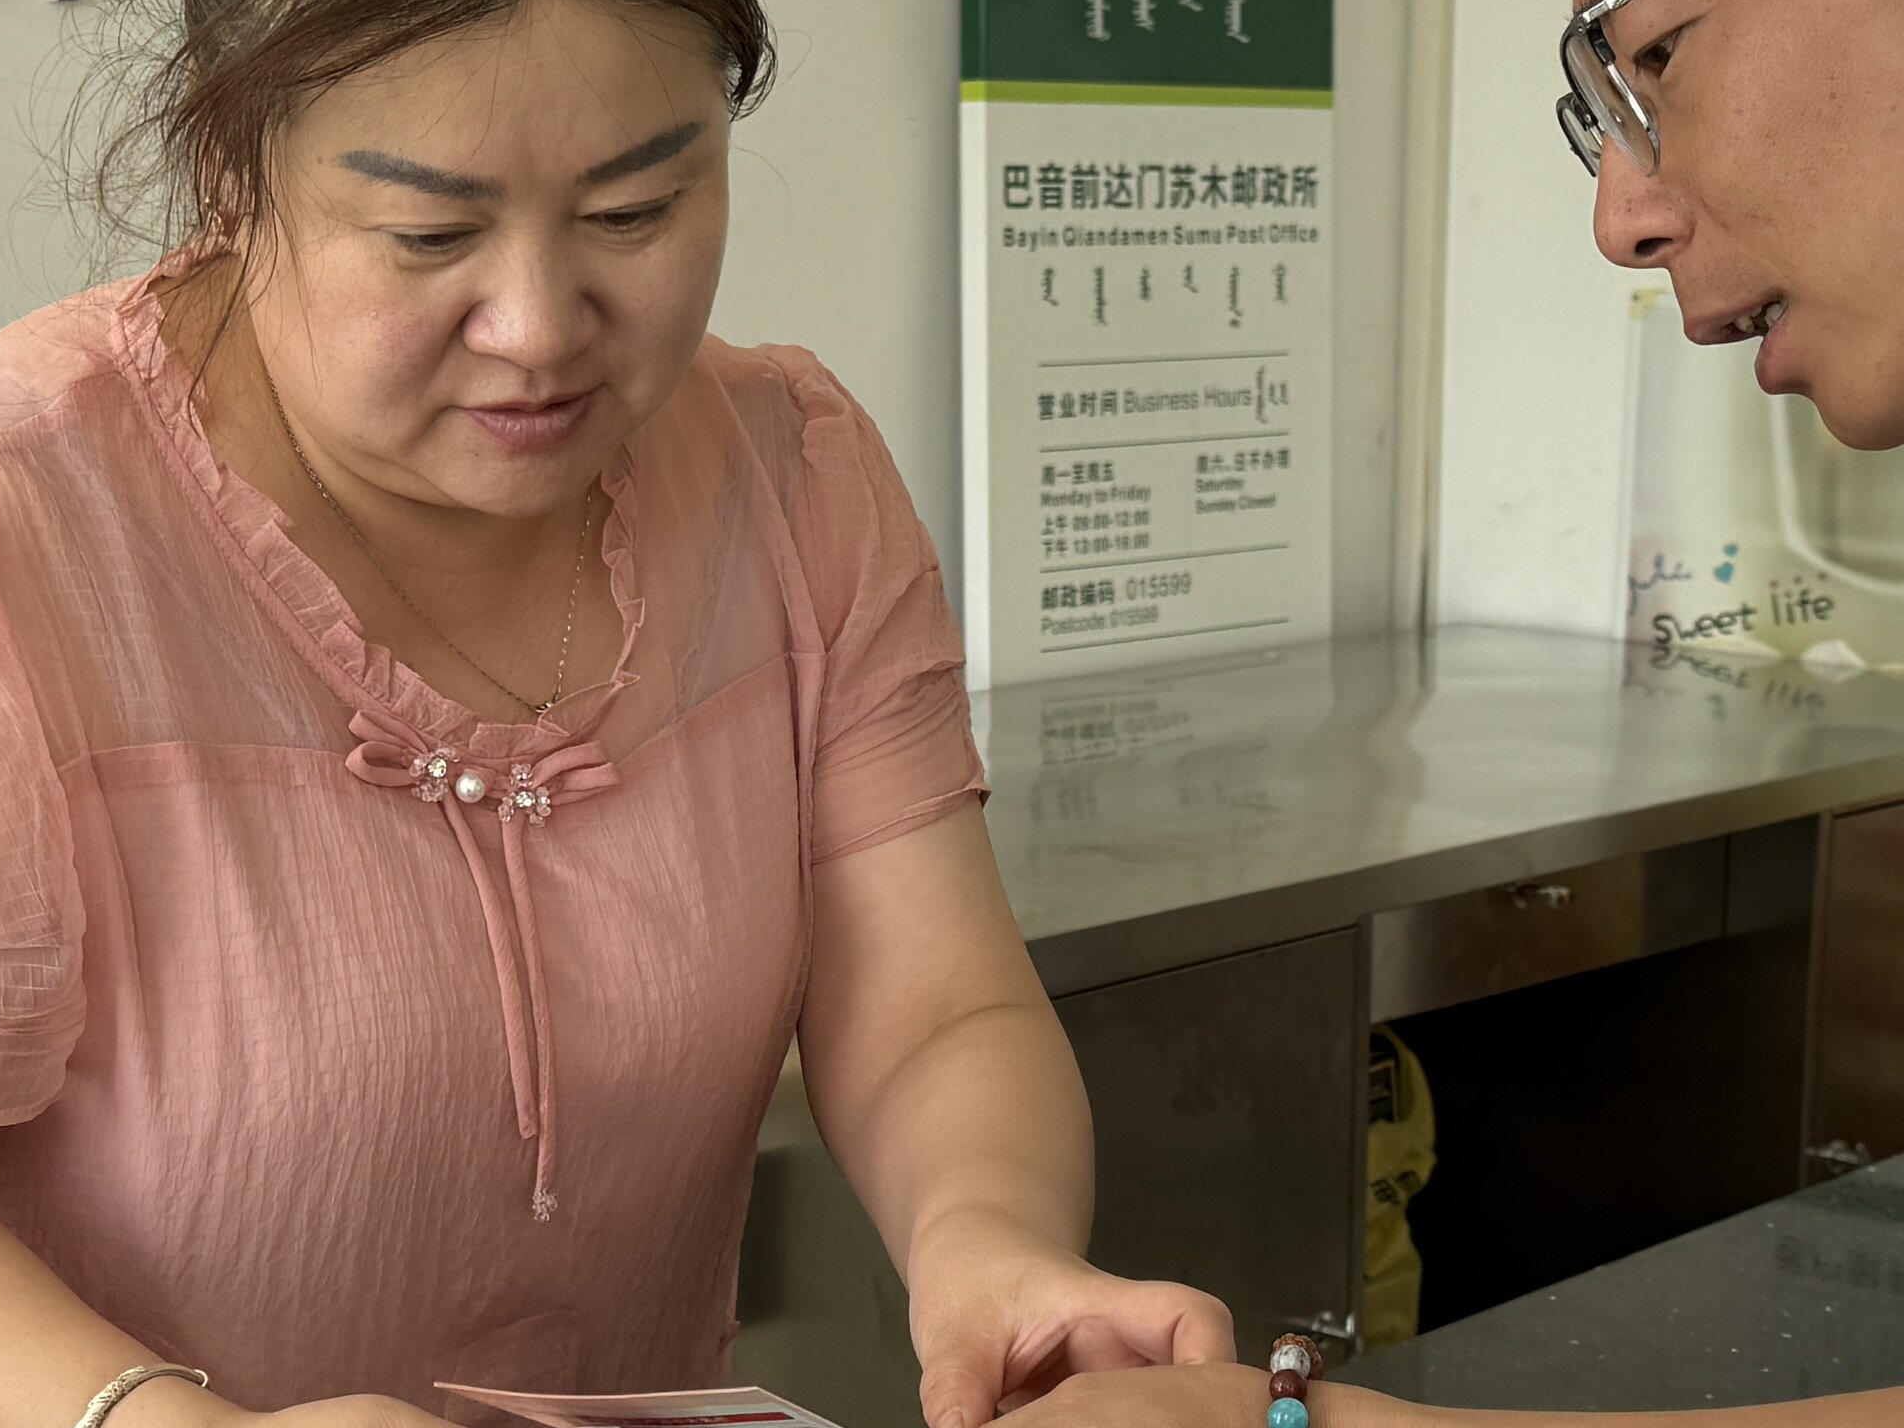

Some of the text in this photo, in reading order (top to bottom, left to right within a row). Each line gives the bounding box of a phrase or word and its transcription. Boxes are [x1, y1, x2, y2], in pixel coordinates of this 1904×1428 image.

[1002, 163, 1319, 211] 巴音前达门苏木邮政所
[1003, 227, 1060, 252] Bayin
[1174, 224, 1222, 246] Sumu
[1227, 224, 1265, 245] Post
[1268, 223, 1319, 245] Office
[1038, 389, 1118, 420] 营业时间
[1124, 389, 1199, 414] Business
[1204, 386, 1252, 408] Hours
